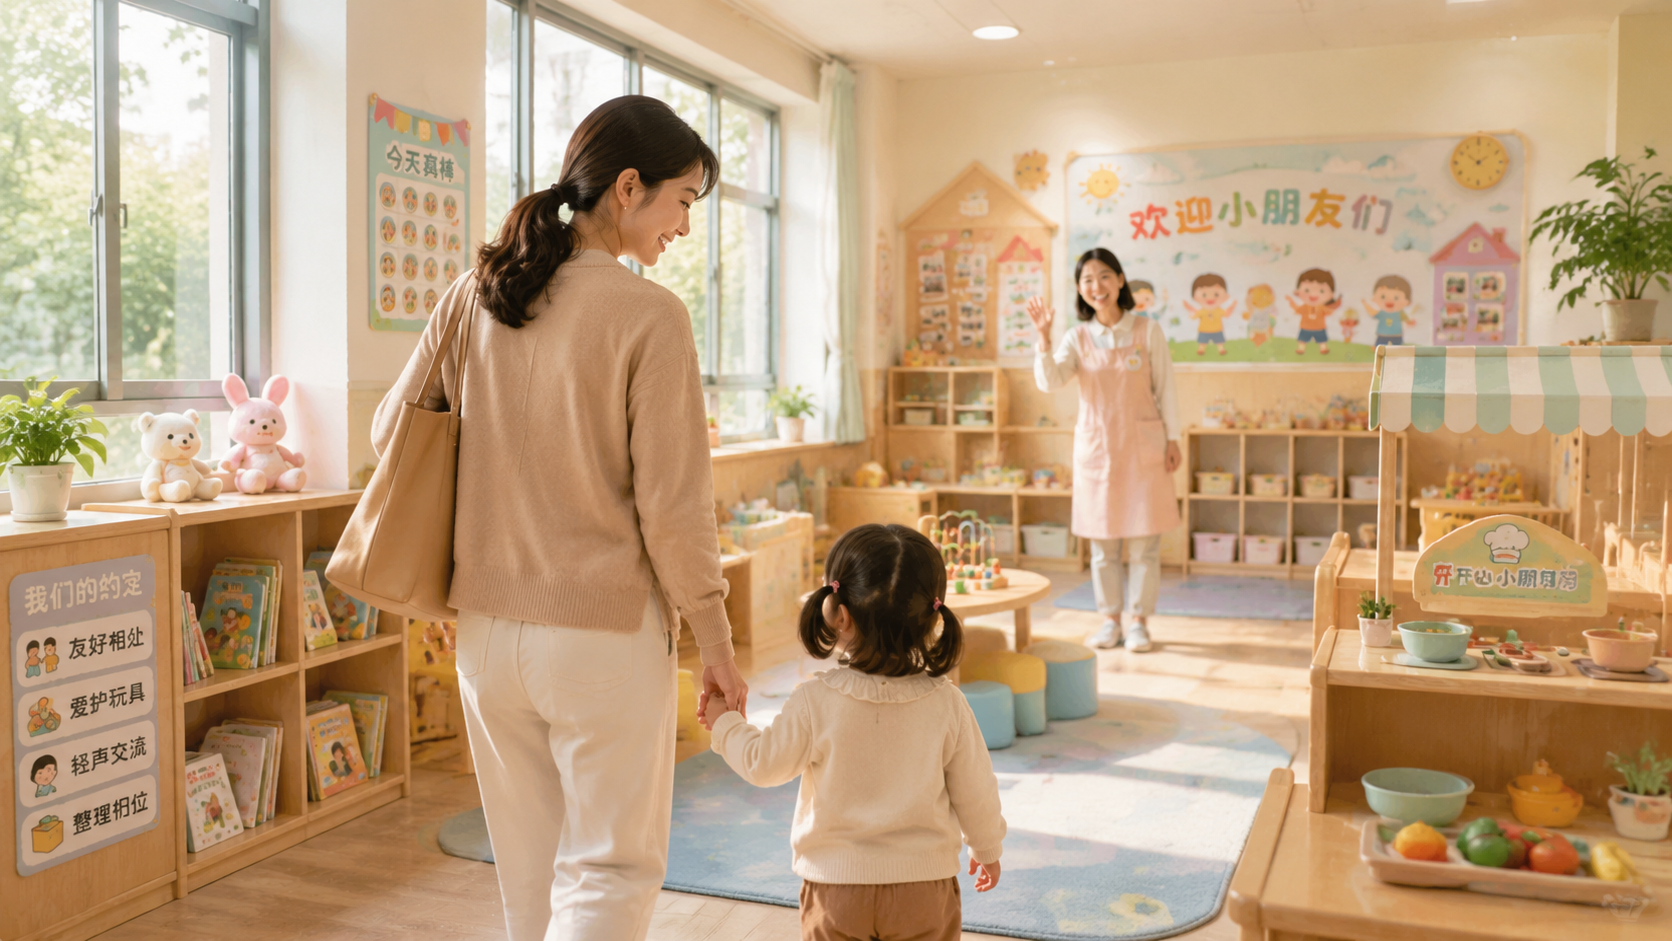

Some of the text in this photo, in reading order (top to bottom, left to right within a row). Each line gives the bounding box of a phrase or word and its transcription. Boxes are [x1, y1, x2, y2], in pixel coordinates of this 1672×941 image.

[1130, 188, 1393, 239] 欢迎小朋友们
[25, 569, 142, 616] 我们的约定
[69, 626, 144, 659] 友好相处
[70, 682, 145, 719] 爱护玩具
[71, 736, 147, 776] 轻声交流
